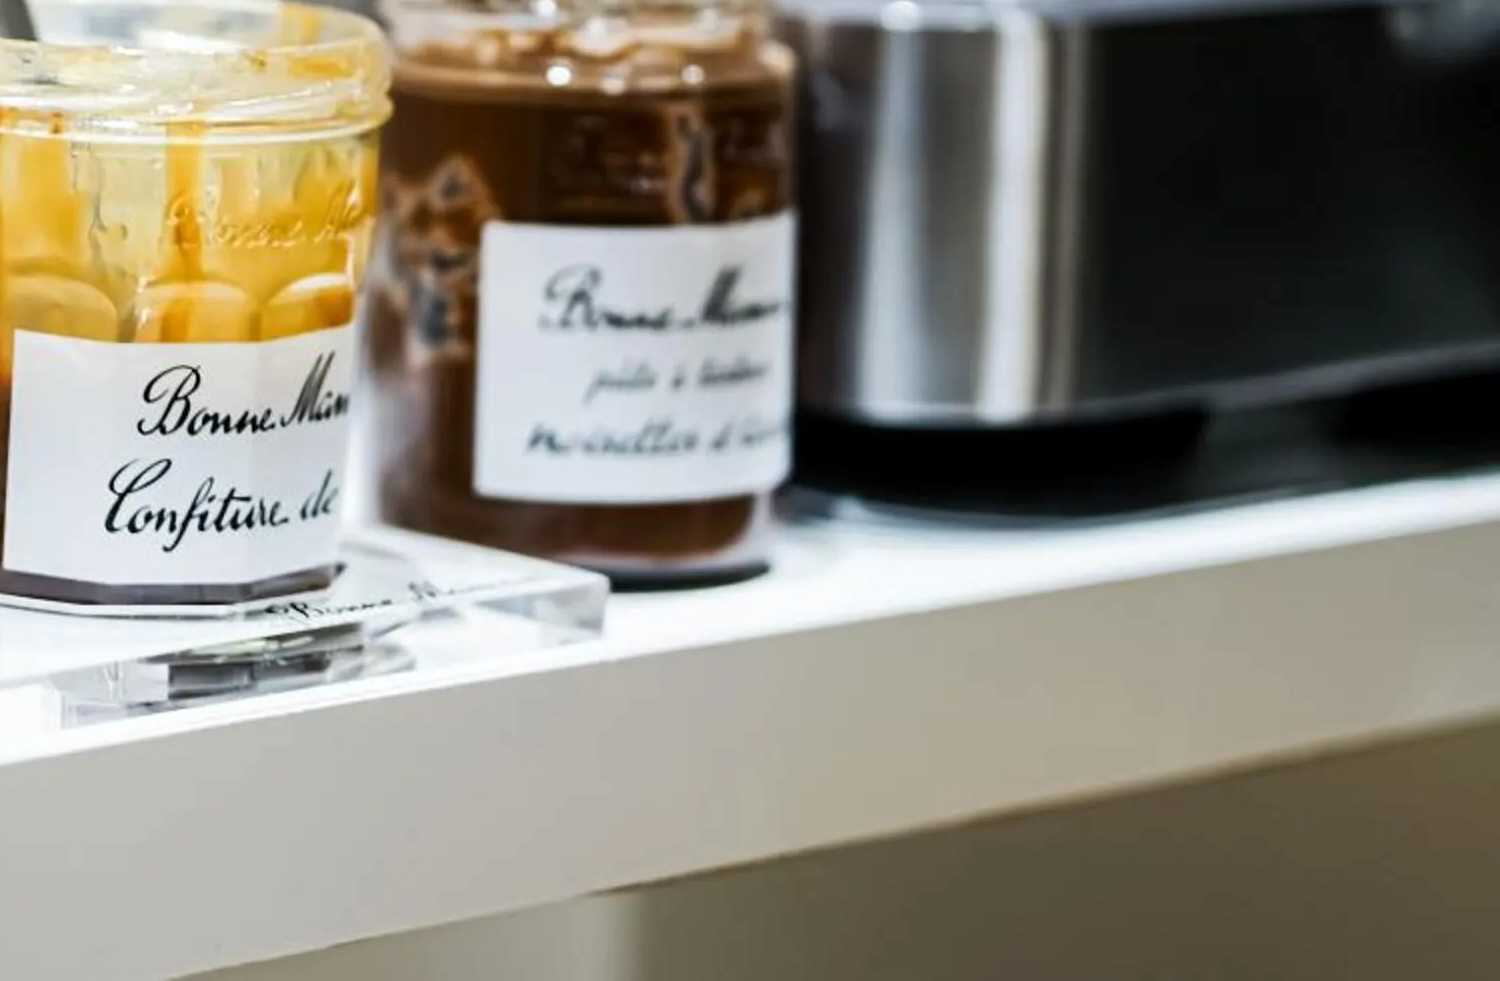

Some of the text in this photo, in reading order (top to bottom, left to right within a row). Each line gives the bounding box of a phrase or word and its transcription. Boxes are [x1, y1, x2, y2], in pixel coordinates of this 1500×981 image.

[137, 350, 349, 436] Bonne Mam
[104, 459, 340, 552] Confiture de
